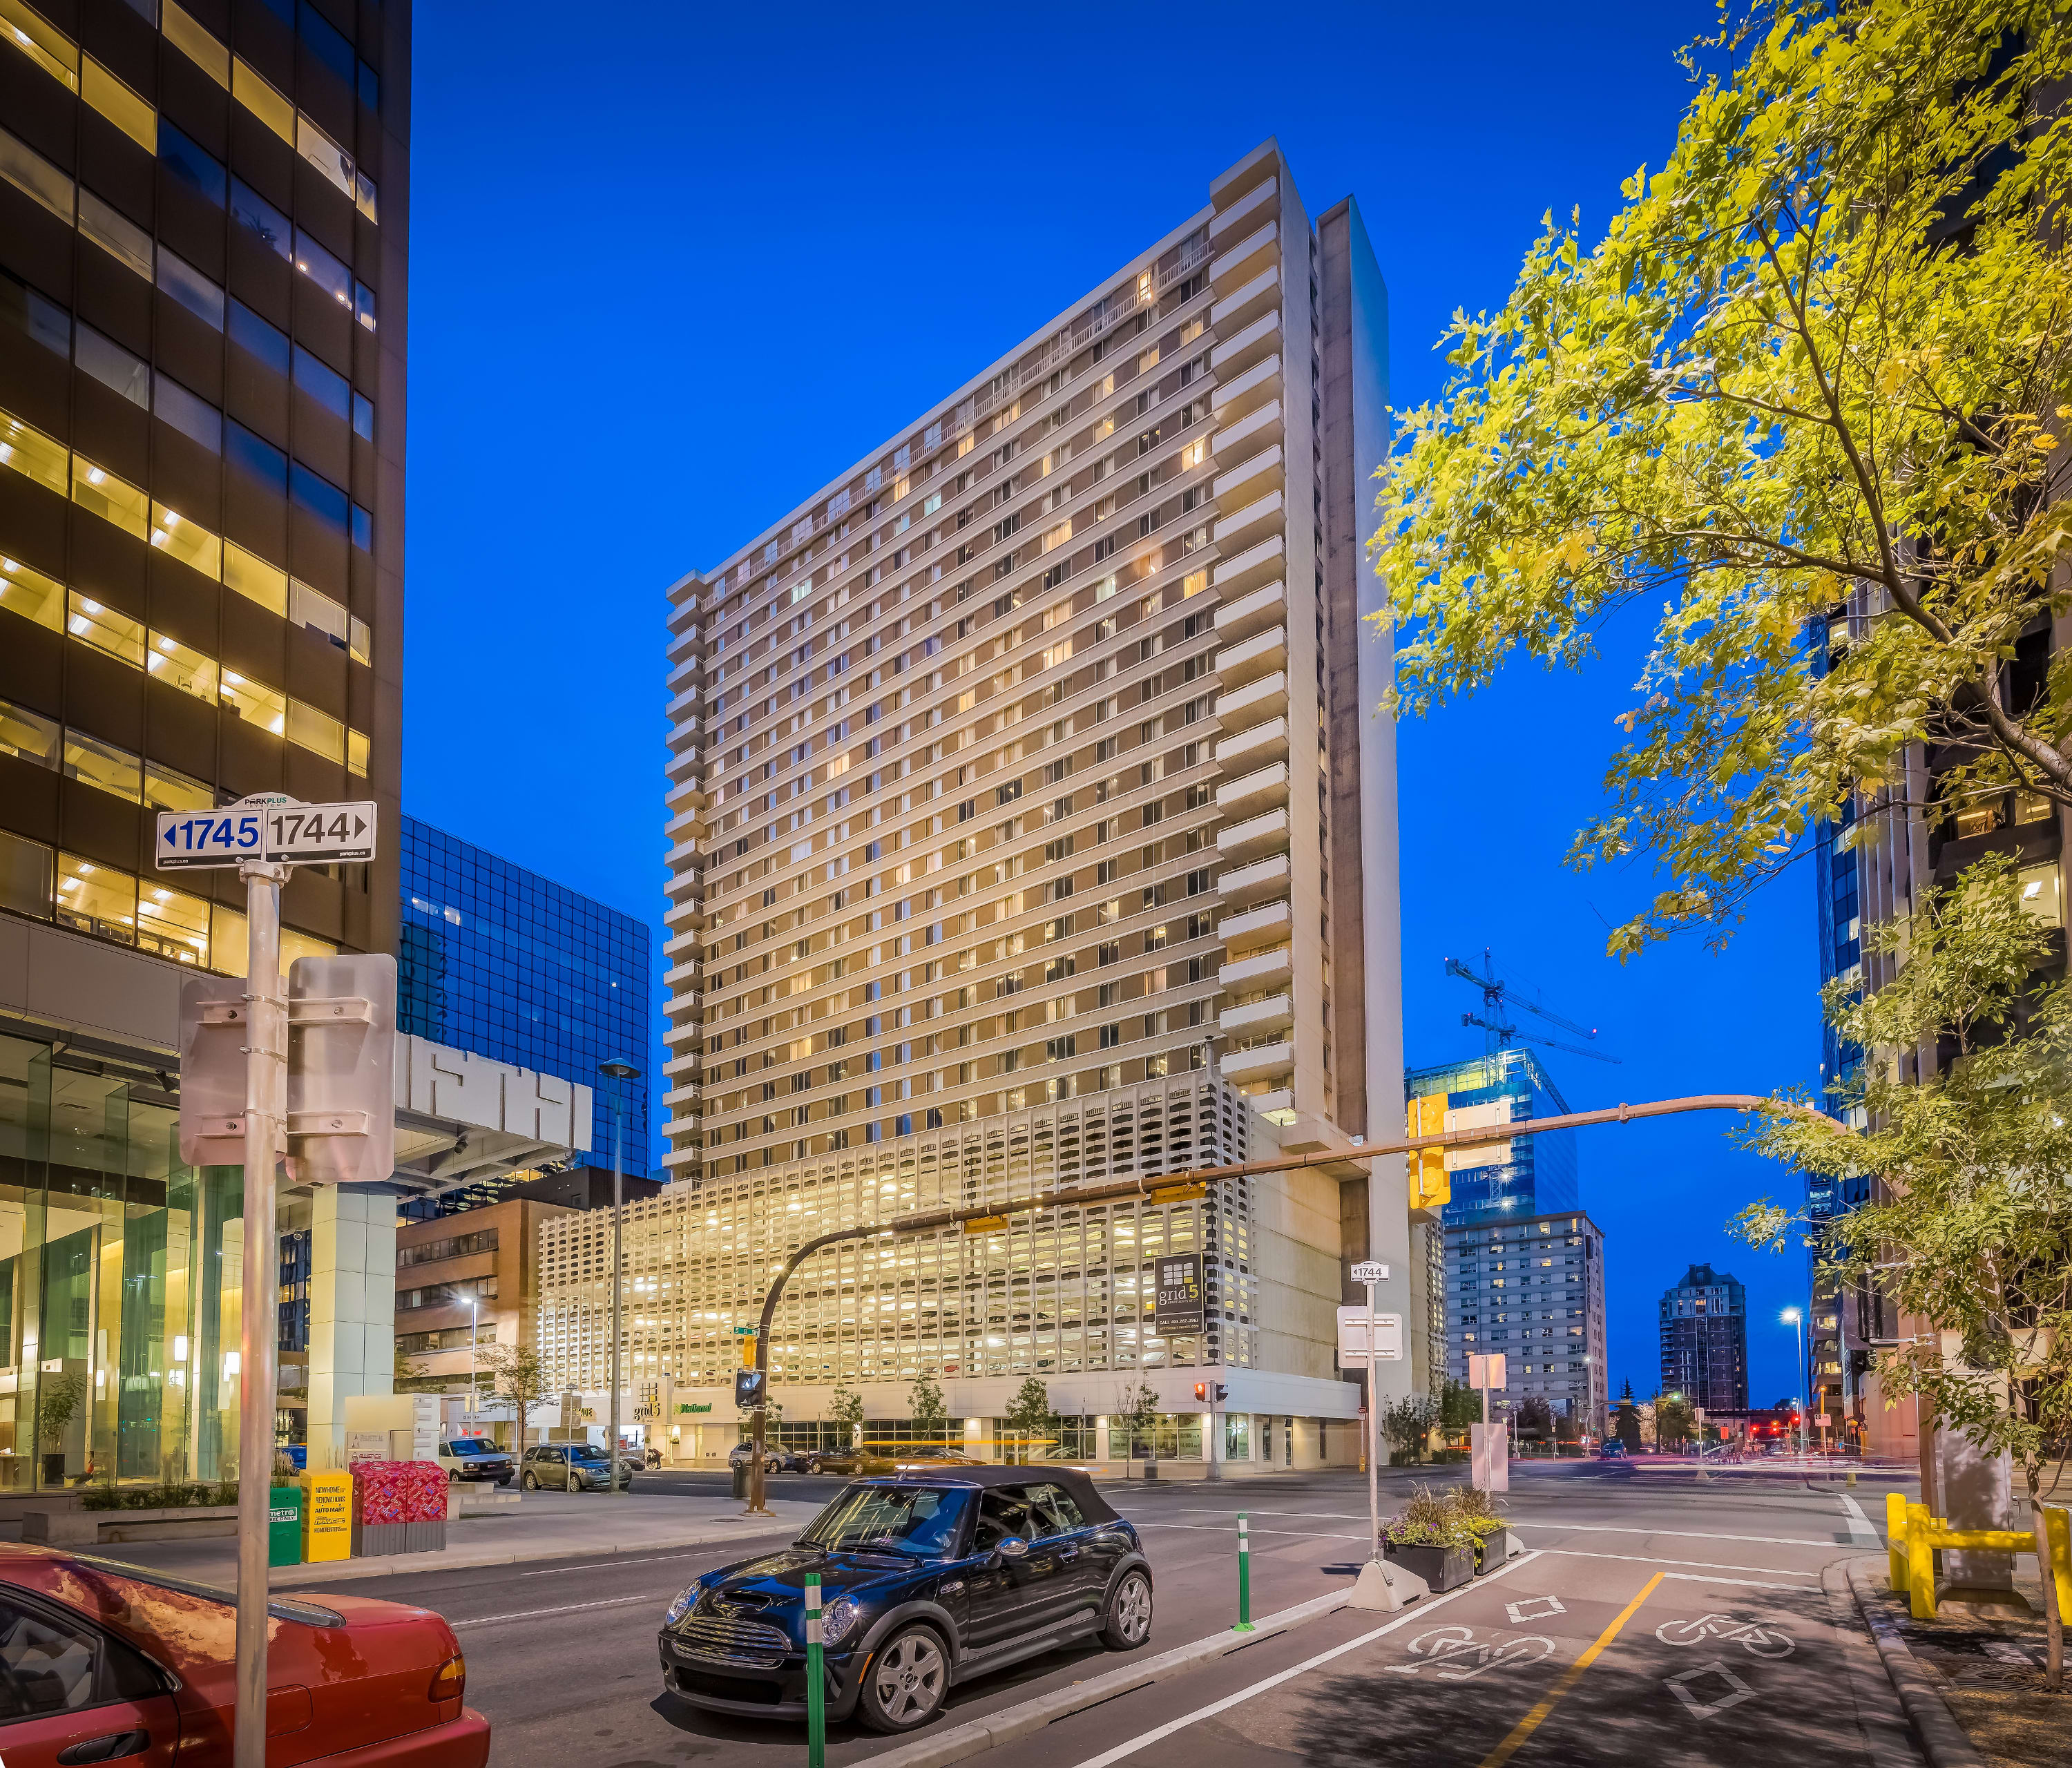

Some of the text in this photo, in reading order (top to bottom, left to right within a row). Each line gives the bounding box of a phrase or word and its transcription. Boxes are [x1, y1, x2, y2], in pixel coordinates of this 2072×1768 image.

[180, 817, 259, 850] 1745
[270, 813, 350, 845] 1744
[1358, 1267, 1382, 1276] 1744
[681, 1403, 712, 1414] National
